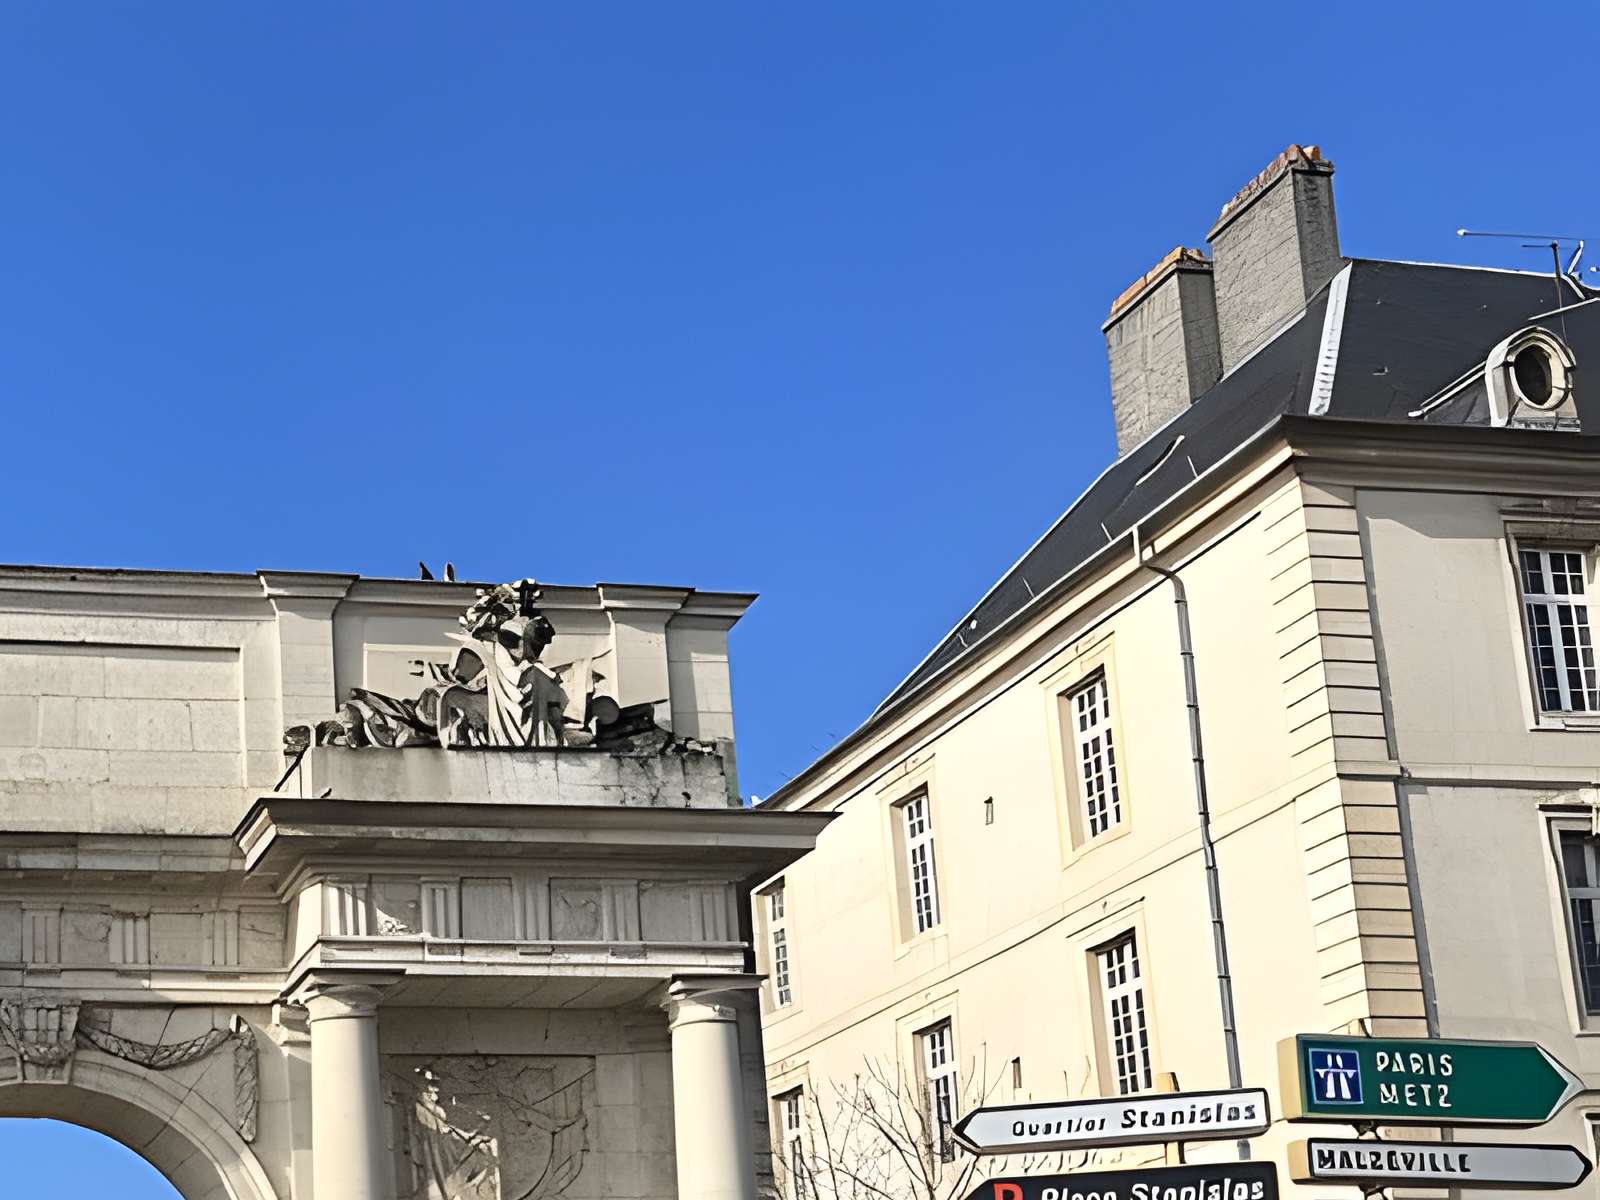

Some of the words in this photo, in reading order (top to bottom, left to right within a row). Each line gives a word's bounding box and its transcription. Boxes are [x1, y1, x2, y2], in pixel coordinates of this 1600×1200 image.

[1376, 1051, 1453, 1076] PARIS
[1379, 1083, 1453, 1107] METZ
[1012, 1117, 1106, 1137] Quartier
[1120, 1102, 1256, 1130] Stanislas
